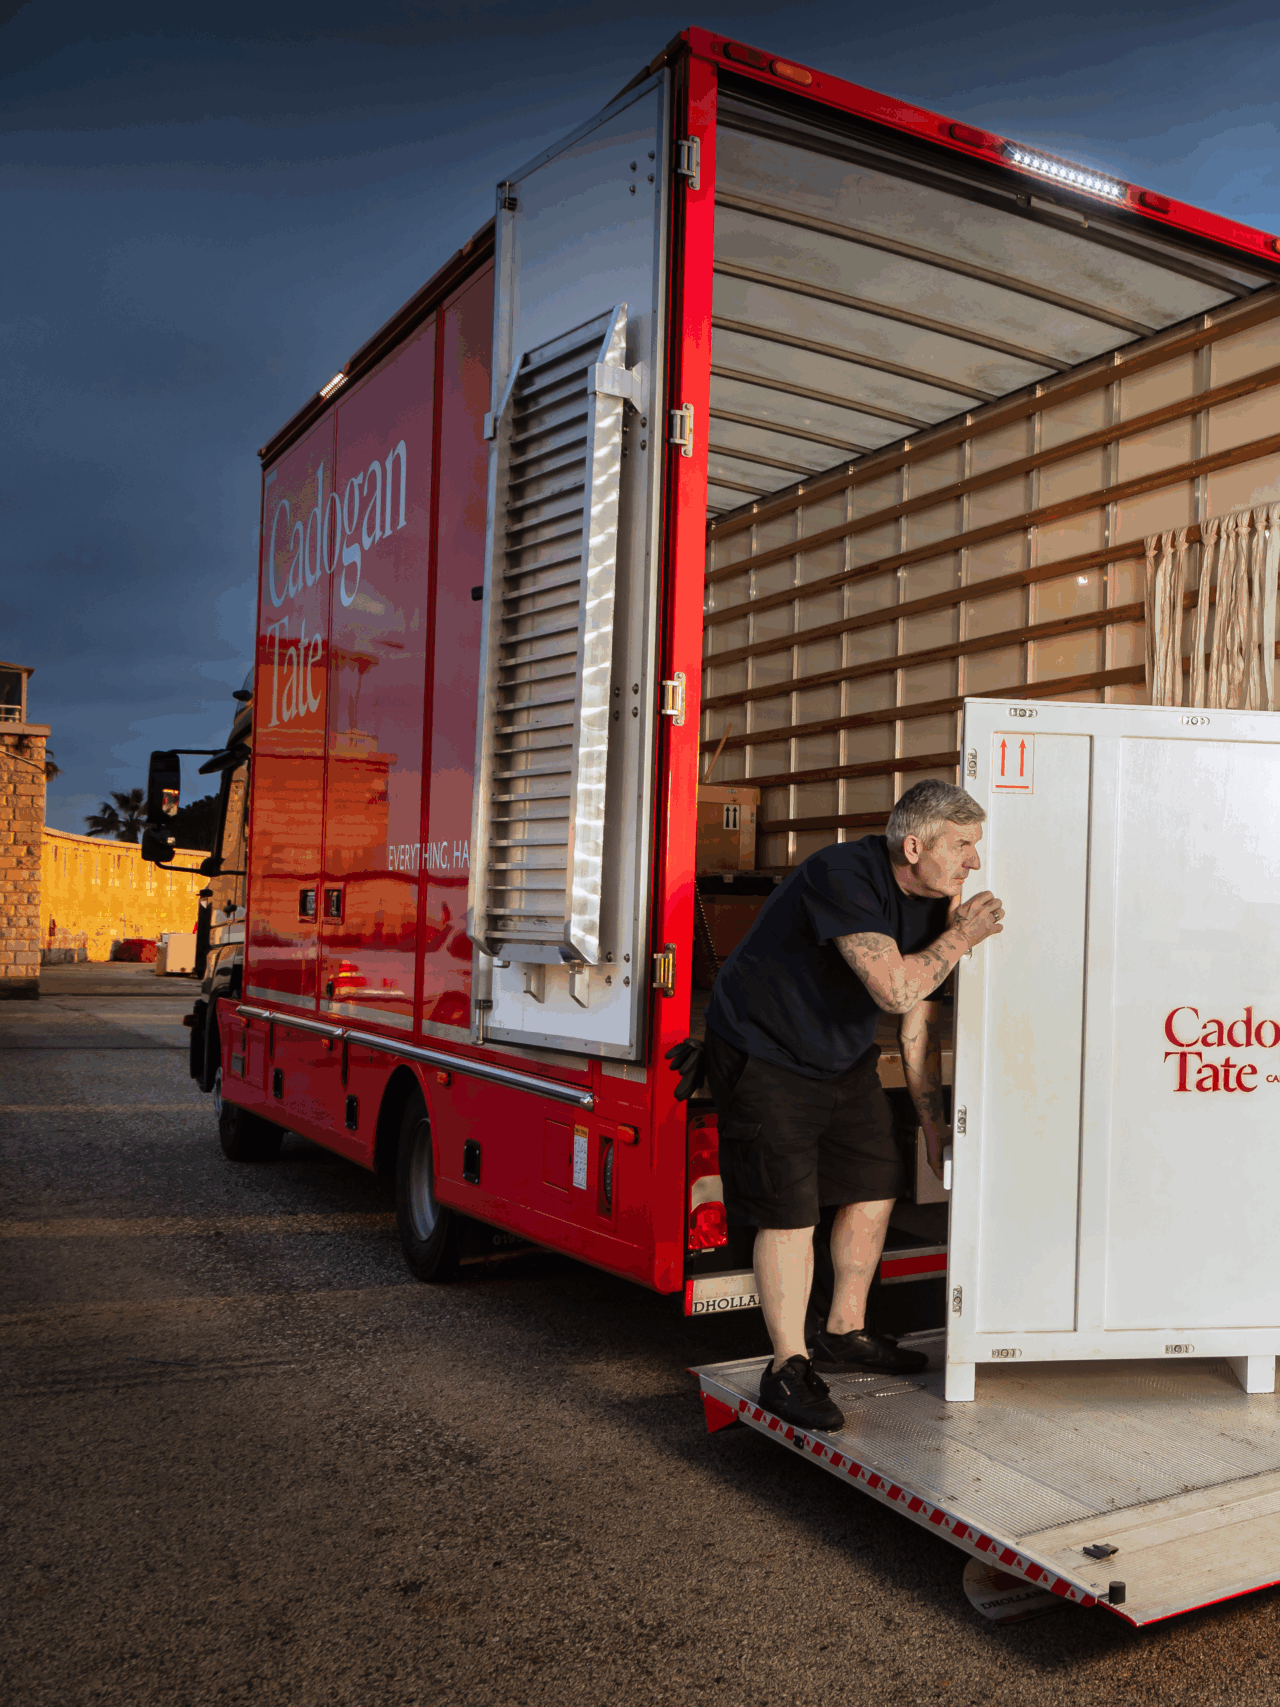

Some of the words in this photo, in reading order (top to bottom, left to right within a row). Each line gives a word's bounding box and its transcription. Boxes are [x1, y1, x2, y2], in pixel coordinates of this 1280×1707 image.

[268, 438, 408, 608] Cadogan
[266, 615, 323, 728] Tate
[388, 841, 450, 871] EVERYTHING,
[452, 839, 470, 868] HA
[1163, 1050, 1258, 1093] Tate
